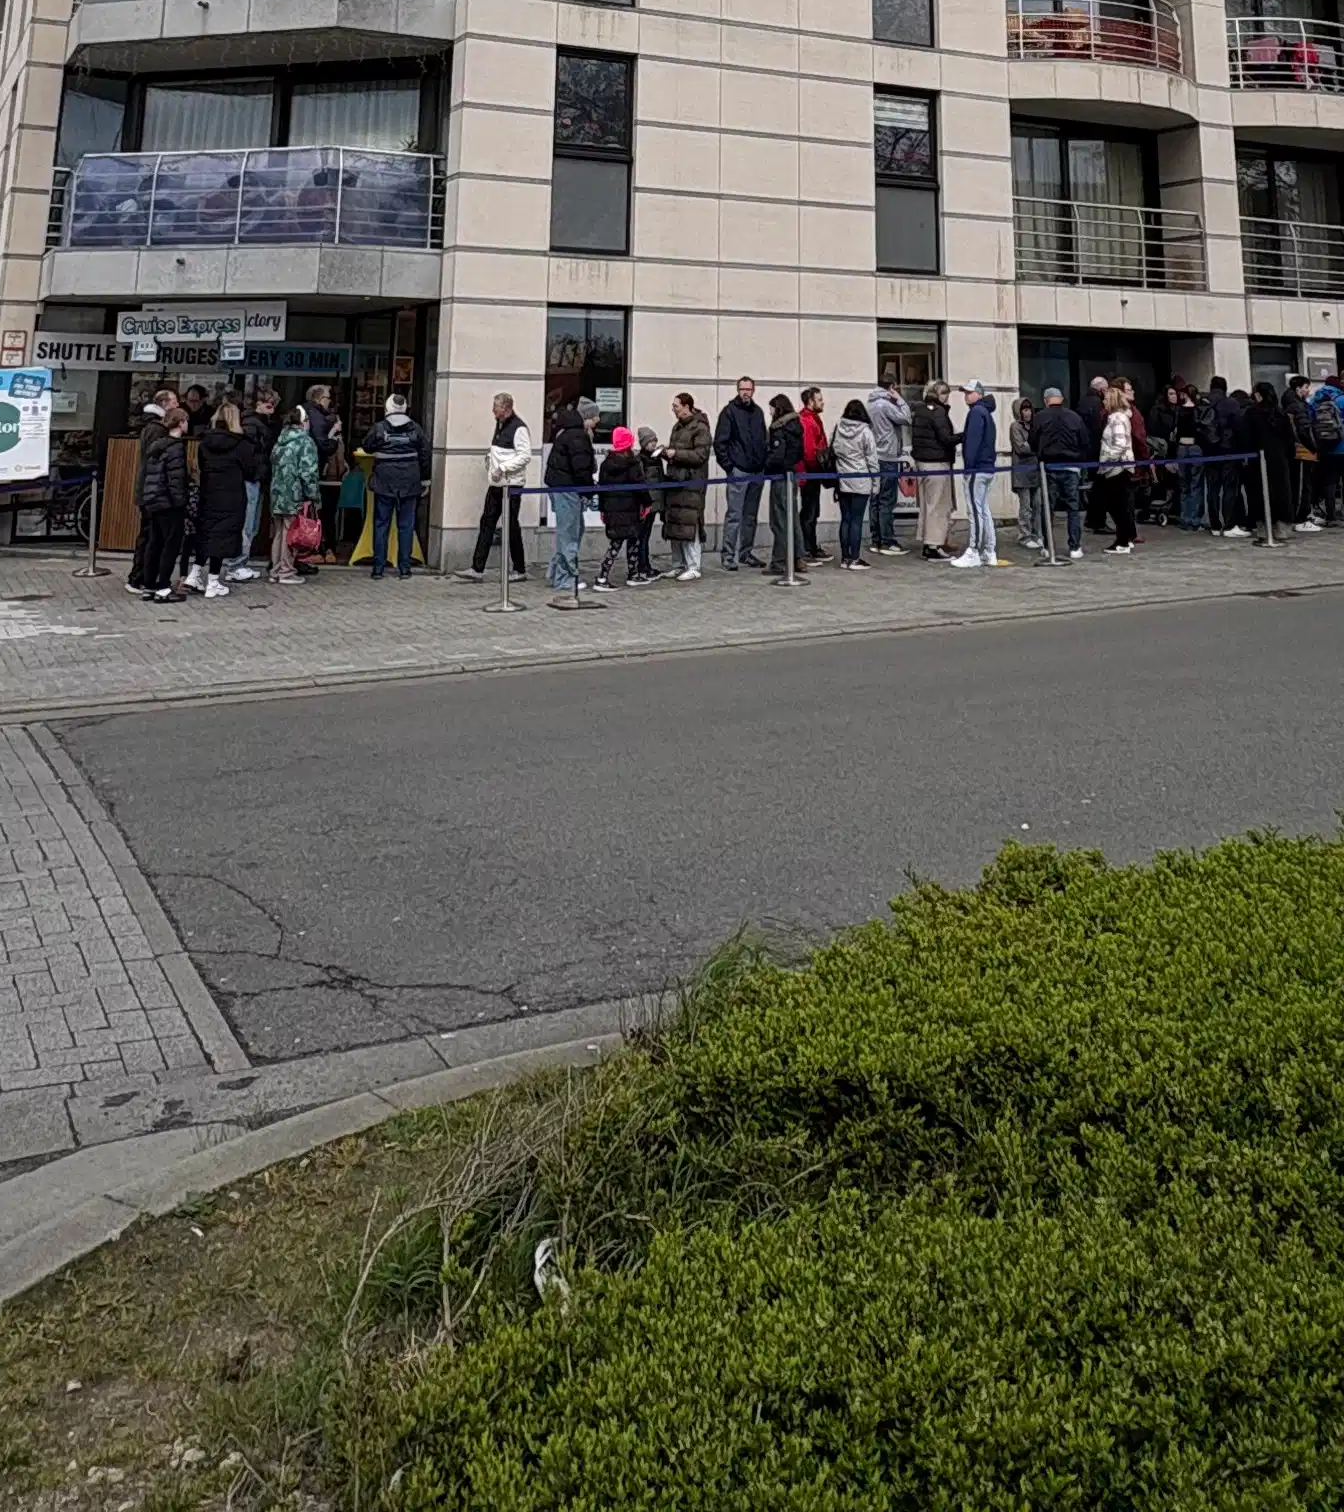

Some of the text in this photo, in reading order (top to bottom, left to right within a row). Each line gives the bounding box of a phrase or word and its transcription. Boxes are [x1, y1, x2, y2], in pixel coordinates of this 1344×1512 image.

[121, 316, 241, 338] Cruise Express
[244, 313, 282, 333] ctory
[36, 341, 117, 362] SHUTTLE
[284, 350, 306, 369] 30
[308, 352, 346, 372] MIN.
